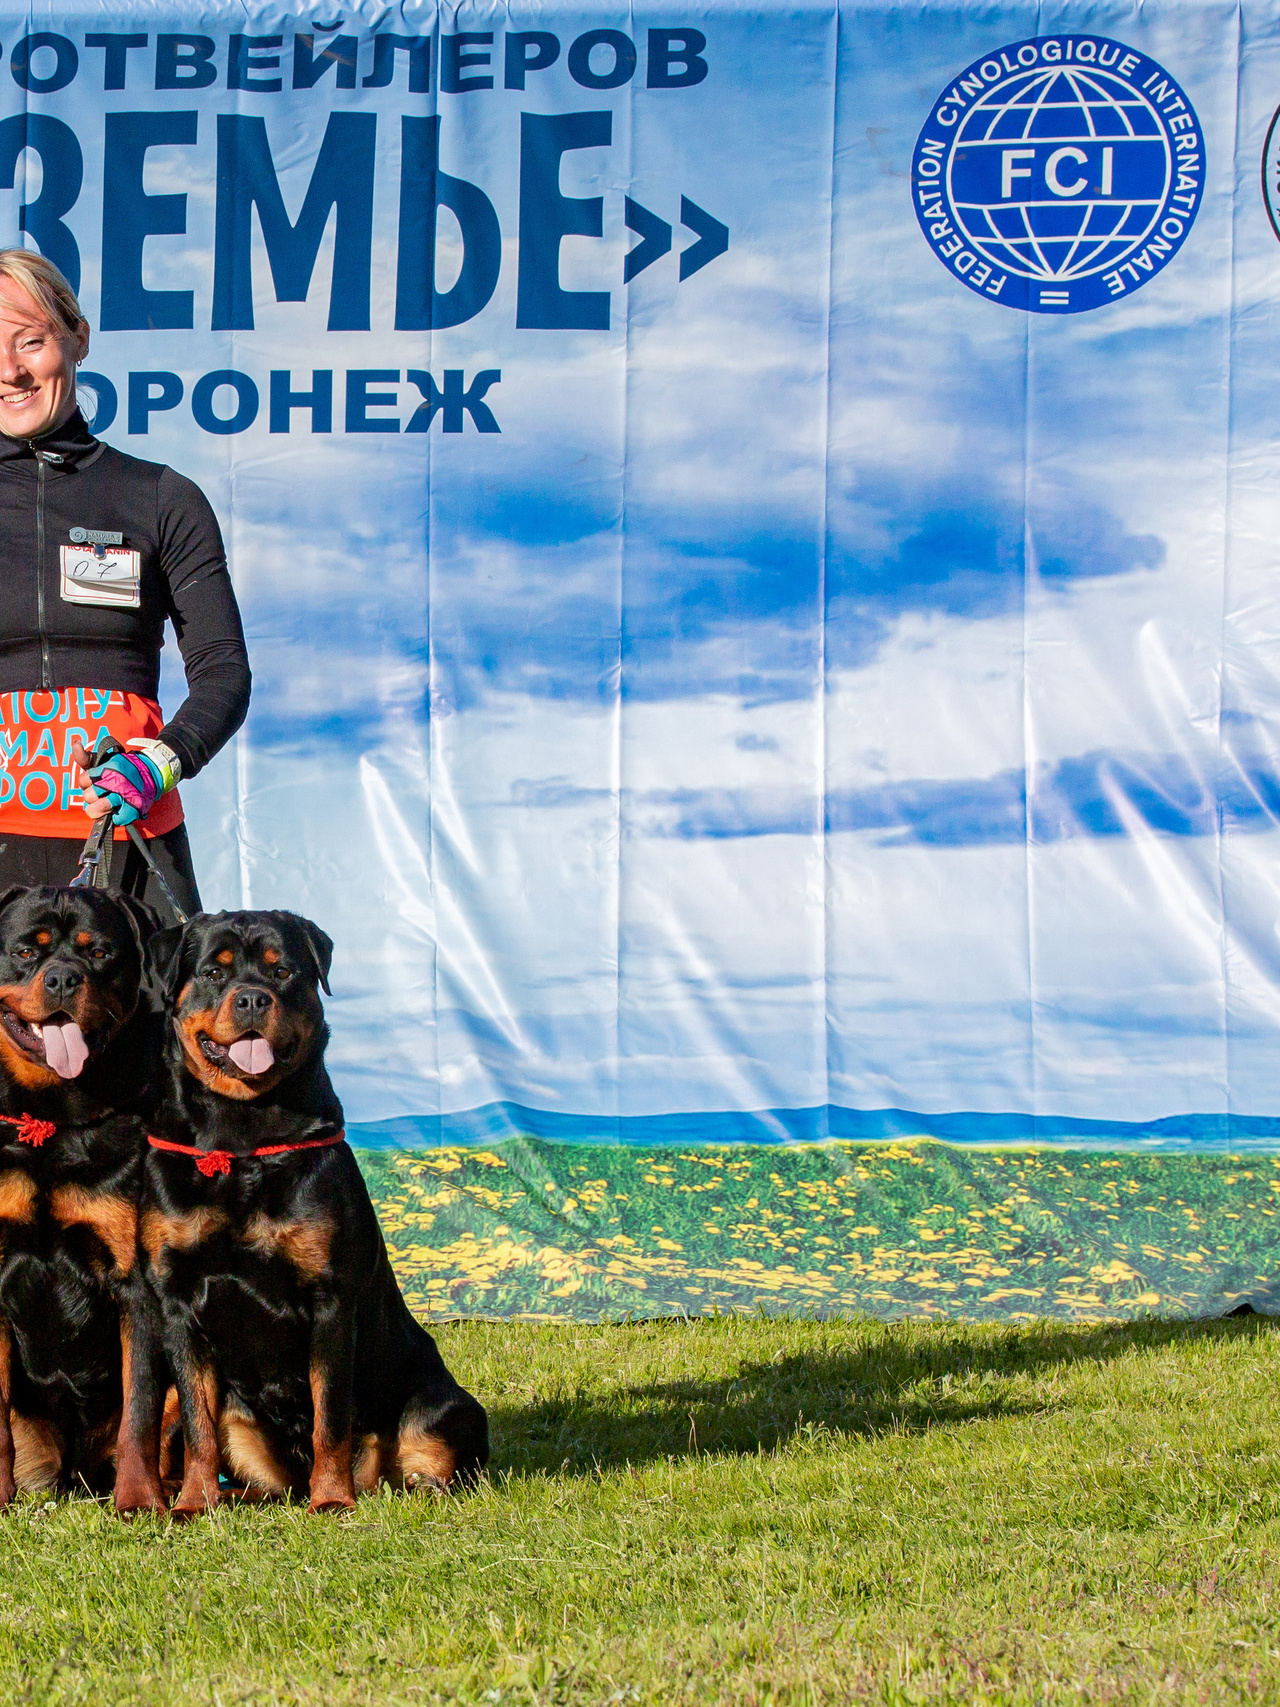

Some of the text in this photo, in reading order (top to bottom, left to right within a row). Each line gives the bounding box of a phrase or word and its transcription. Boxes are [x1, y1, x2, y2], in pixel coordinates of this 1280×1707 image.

[936, 40, 1141, 127] CYNOLOGIQUE
[1001, 146, 1113, 198] FCI
[1102, 71, 1200, 295] INTERNATIONALE
[918, 138, 1007, 296] FEDERATION
[67, 545, 131, 556] ROYA ANIN
